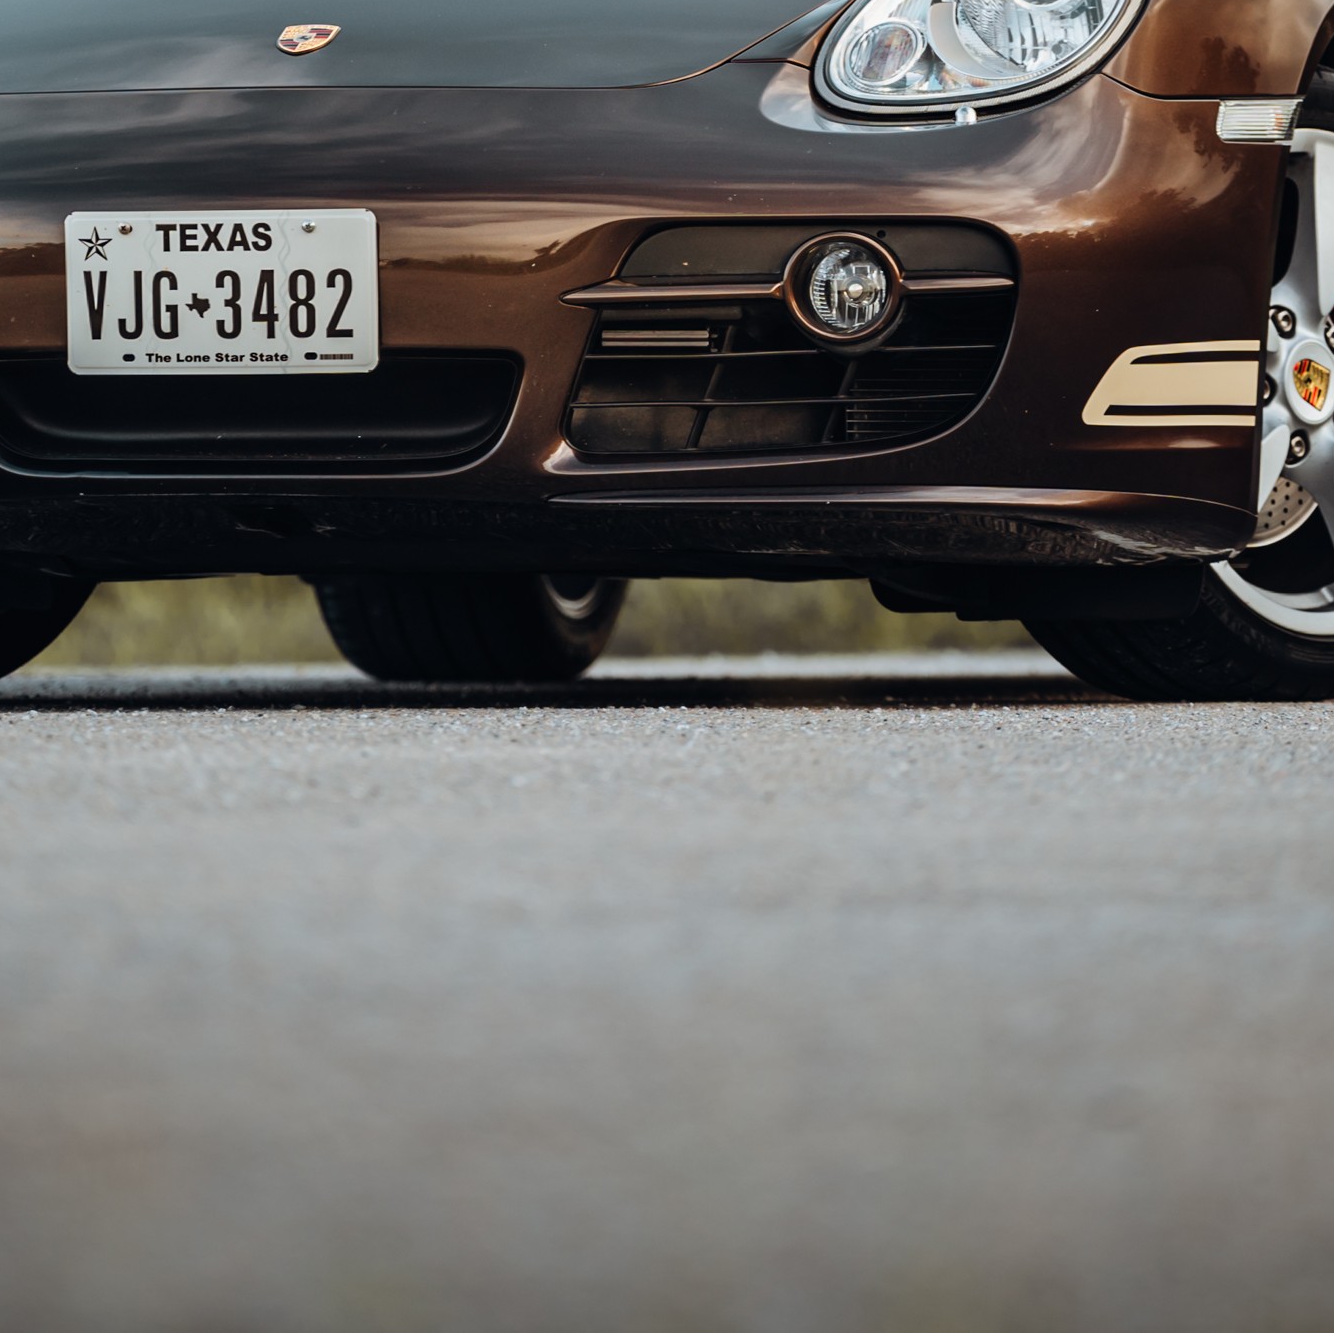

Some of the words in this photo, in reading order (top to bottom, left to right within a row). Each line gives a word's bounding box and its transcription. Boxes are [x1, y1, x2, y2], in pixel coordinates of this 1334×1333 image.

[155, 222, 274, 253] TEXAS
[83, 269, 180, 341] VJG
[214, 267, 355, 340] 3482
[144, 352, 173, 364] The
[176, 352, 212, 363] Lone
[214, 351, 246, 363] Star
[248, 351, 290, 363] State
